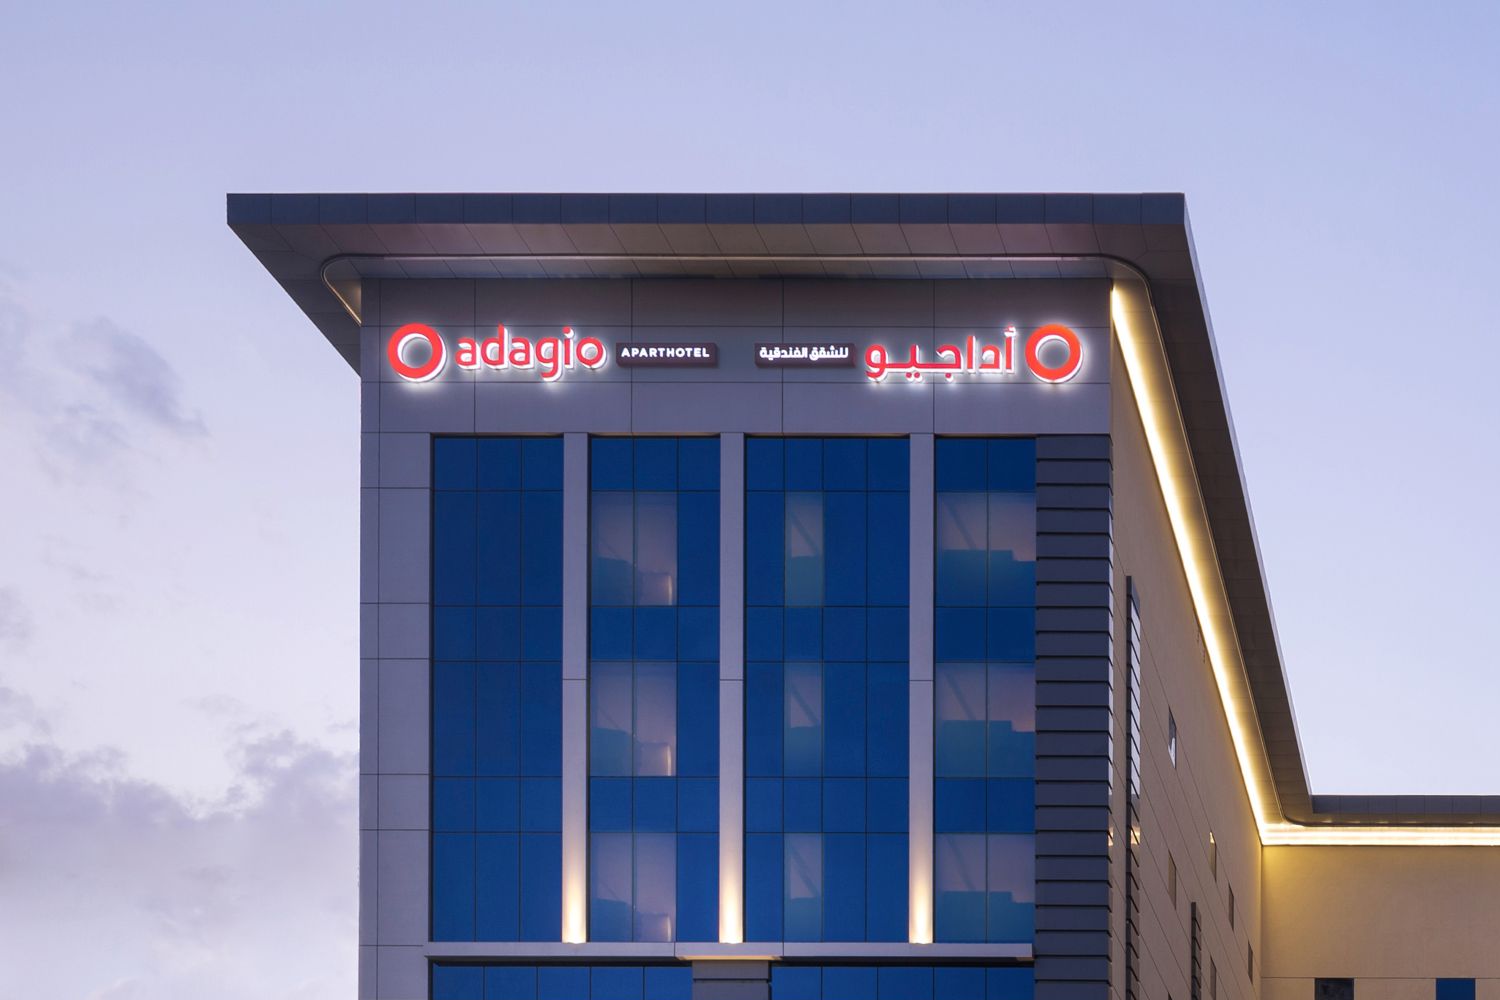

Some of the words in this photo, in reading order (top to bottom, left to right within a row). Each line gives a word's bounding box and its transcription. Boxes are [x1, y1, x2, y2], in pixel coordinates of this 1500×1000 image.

[455, 322, 606, 381] adagio
[621, 346, 710, 358] APARTHOTEL
[760, 346, 808, 361] الفندقية
[809, 345, 849, 361] للشقق
[865, 325, 1017, 383] أداجيو
